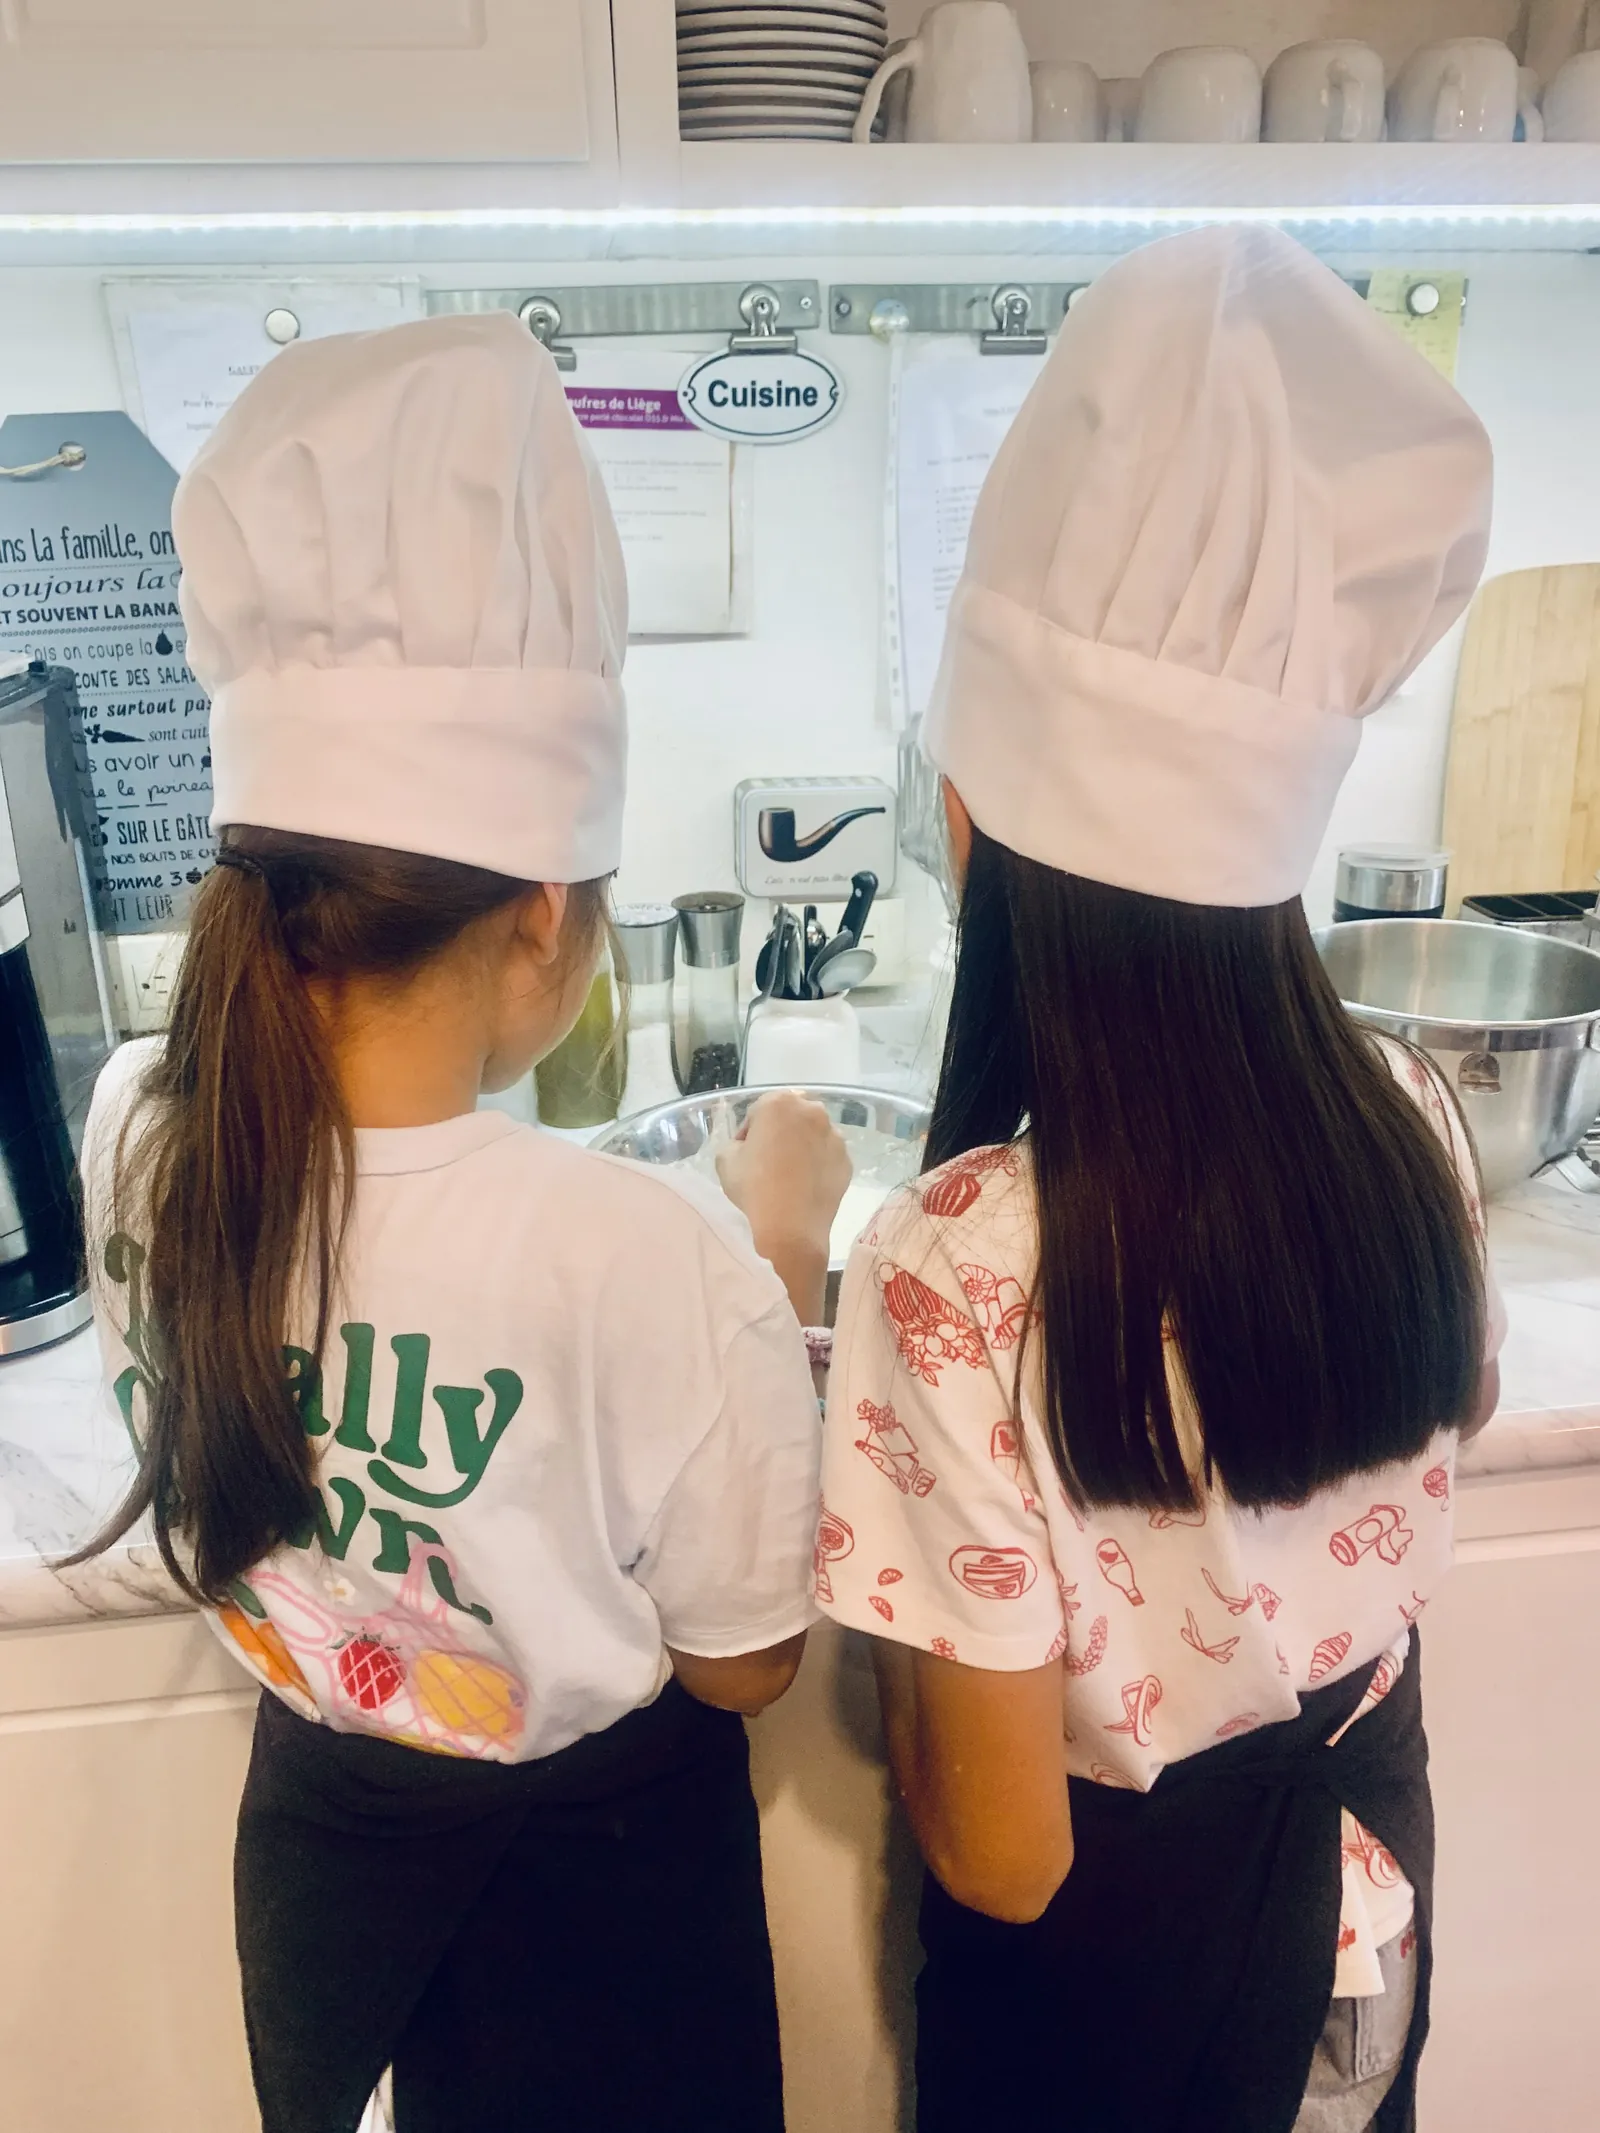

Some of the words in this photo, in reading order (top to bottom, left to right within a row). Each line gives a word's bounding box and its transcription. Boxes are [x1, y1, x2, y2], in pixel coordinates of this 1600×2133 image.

[608, 396, 625, 410] de
[708, 379, 818, 407] Cuisine
[0, 538, 26, 563] ns
[30, 528, 54, 562] la
[61, 524, 143, 560] famille,
[149, 530, 175, 555] on
[136, 568, 166, 591] la
[17, 606, 98, 624] SOUVENT
[103, 603, 125, 619] LA
[63, 646, 83, 661] on
[88, 640, 134, 662] coupe
[127, 670, 151, 686] DES
[106, 697, 176, 717] surtout
[149, 729, 178, 742] sont
[104, 753, 160, 772] avoir
[168, 752, 195, 768] un
[117, 779, 136, 797] le
[116, 820, 149, 845] SUR
[153, 818, 172, 842] LE
[111, 854, 136, 866] NOS
[139, 851, 177, 863] BOUTS
[181, 849, 196, 861] DE
[170, 871, 183, 887] 3
[135, 894, 175, 922] LEUR
